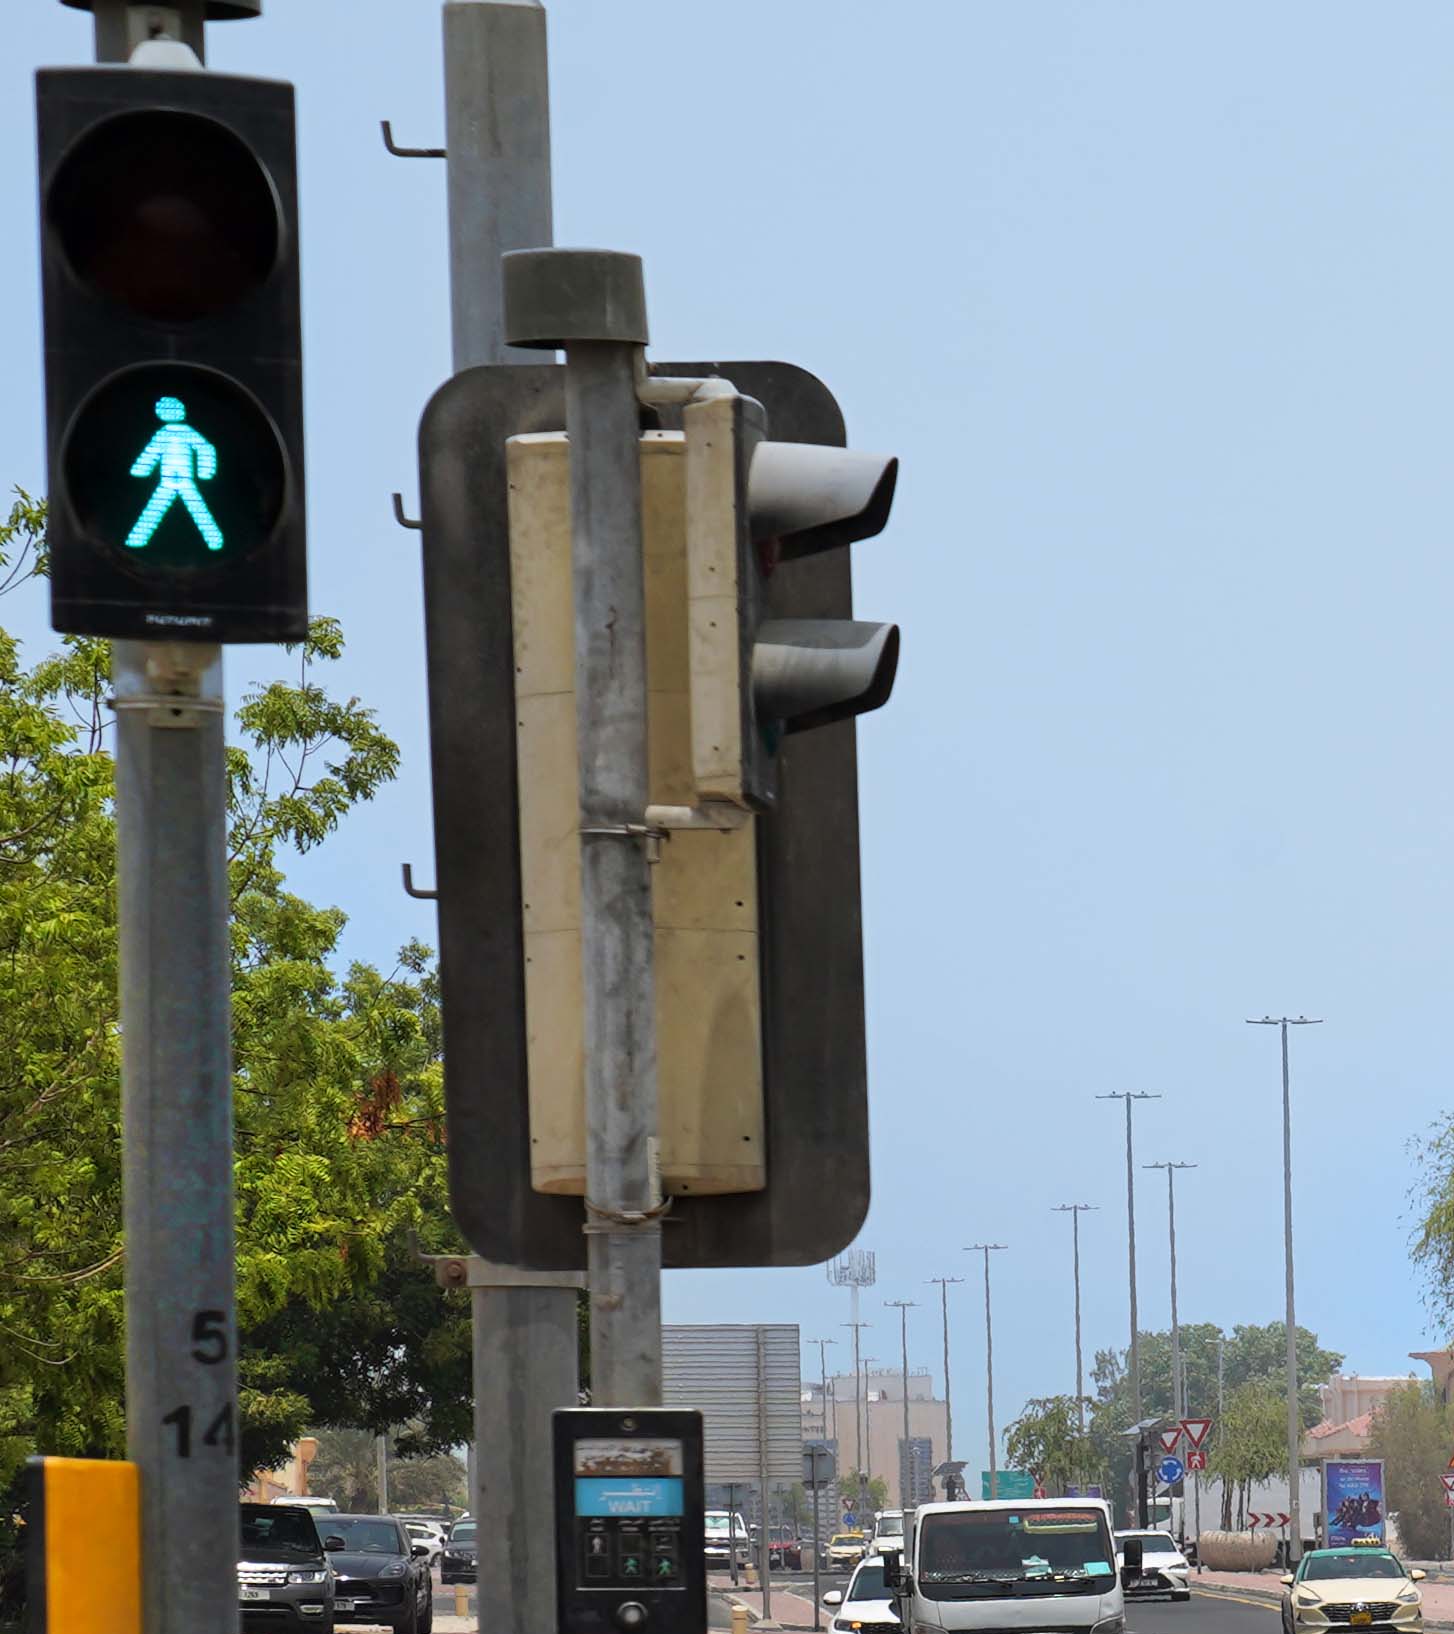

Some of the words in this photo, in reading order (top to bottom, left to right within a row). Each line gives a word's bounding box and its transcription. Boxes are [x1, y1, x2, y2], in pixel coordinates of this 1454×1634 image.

[191, 1310, 228, 1366] 5
[162, 1403, 236, 1459] 14
[607, 1500, 653, 1513] WAIT
